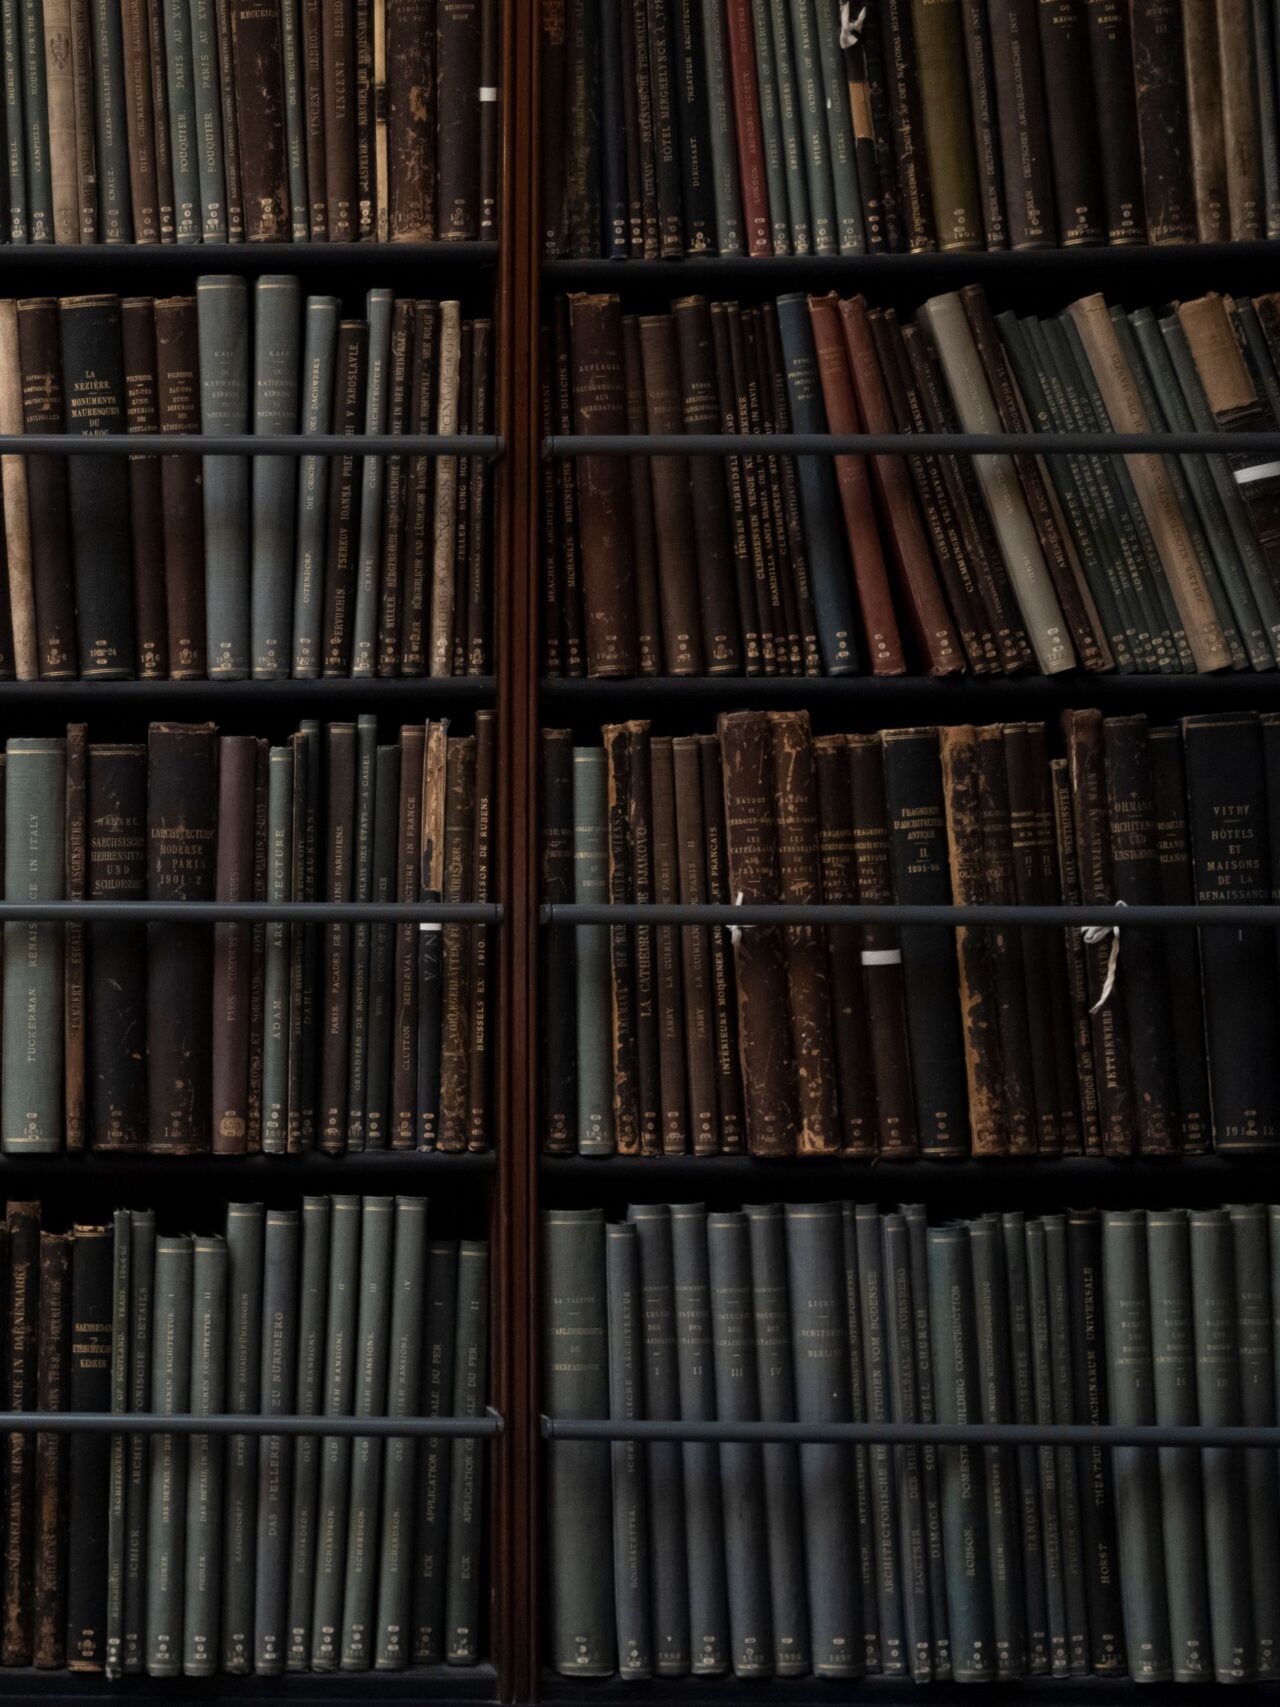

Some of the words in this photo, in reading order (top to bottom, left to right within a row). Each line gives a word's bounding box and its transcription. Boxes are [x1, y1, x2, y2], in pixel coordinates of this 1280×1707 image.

[173, 29, 183, 43] AU
[199, 31, 209, 44] AU
[174, 55, 185, 88] PARIS
[200, 54, 211, 88] PARIS
[176, 110, 188, 172] FOUQUIER.
[72, 407, 120, 417] MAURESQUES
[338, 527, 350, 570] TSERKOV
[406, 797, 416, 837] FRANCE
[1214, 805, 1249, 816] VITRY
[29, 813, 39, 851] ITALY
[1229, 844, 1241, 854] ET
[28, 859, 39, 872] IN
[107, 864, 130, 875] UND
[1208, 859, 1260, 871] MAISONS
[1218, 875, 1232, 885] DE
[272, 999, 283, 1040] ADAM
[639, 1000, 653, 1017] LA
[27, 988, 37, 1064] TUCKERMAN
[476, 1000, 486, 1052] BRUSSELS
[402, 1025, 412, 1071] CLUTTON
[866, 1271, 880, 1330] BODENSEE
[917, 1309, 930, 1369] CHURCH
[951, 1285, 965, 1372] CONSTRUCTION
[271, 1311, 284, 1382] NÜRNBERG
[870, 1336, 882, 1362] VOM
[271, 1388, 282, 1407] ZU
[130, 1529, 141, 1579] SCHICK
[136, 1286, 147, 1340] DETAILS
[267, 1512, 278, 1536] DAS
[1098, 1543, 1111, 1585] HORST
